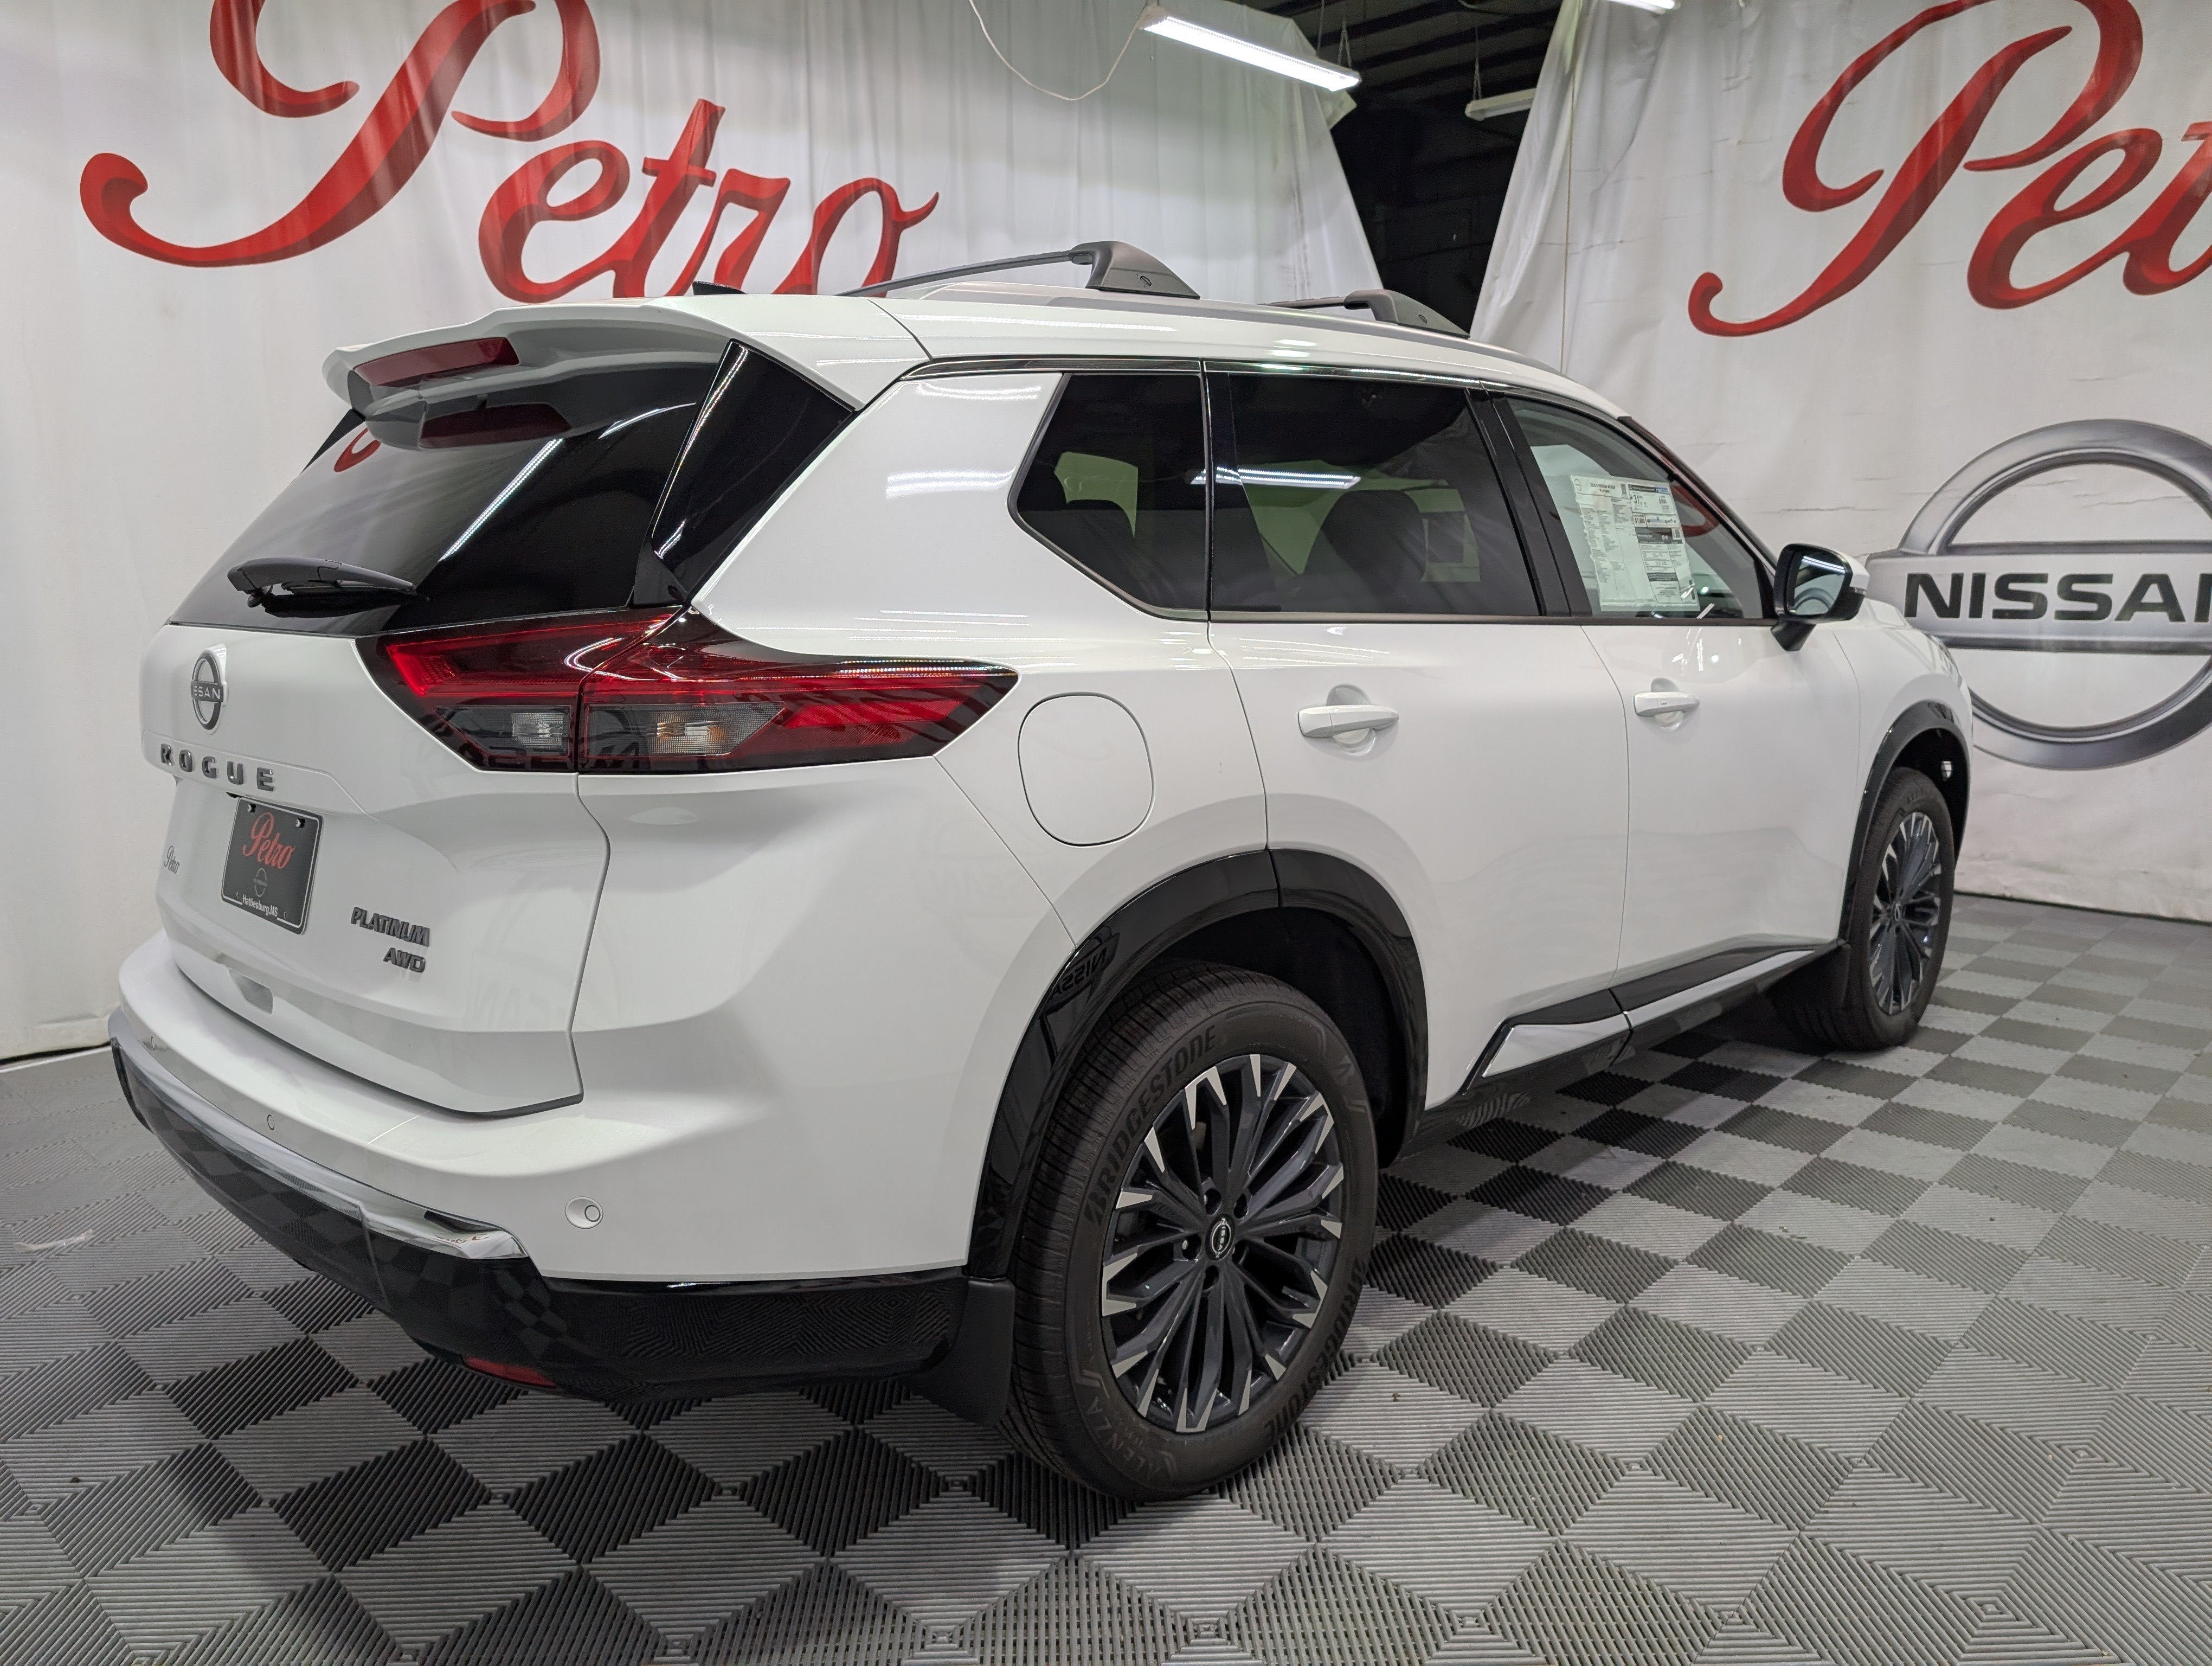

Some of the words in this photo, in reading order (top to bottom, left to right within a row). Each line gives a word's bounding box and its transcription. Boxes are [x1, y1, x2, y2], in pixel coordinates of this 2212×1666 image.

[80, 0, 939, 303] Petro
[160, 744, 274, 791] ROGUE
[242, 812, 295, 869] Petro
[351, 907, 430, 947] PLATINUM
[383, 947, 426, 973] AWD
[1085, 1024, 1217, 1228] BRIDGESTONE
[1216, 1218, 1226, 1258] NISSAN
